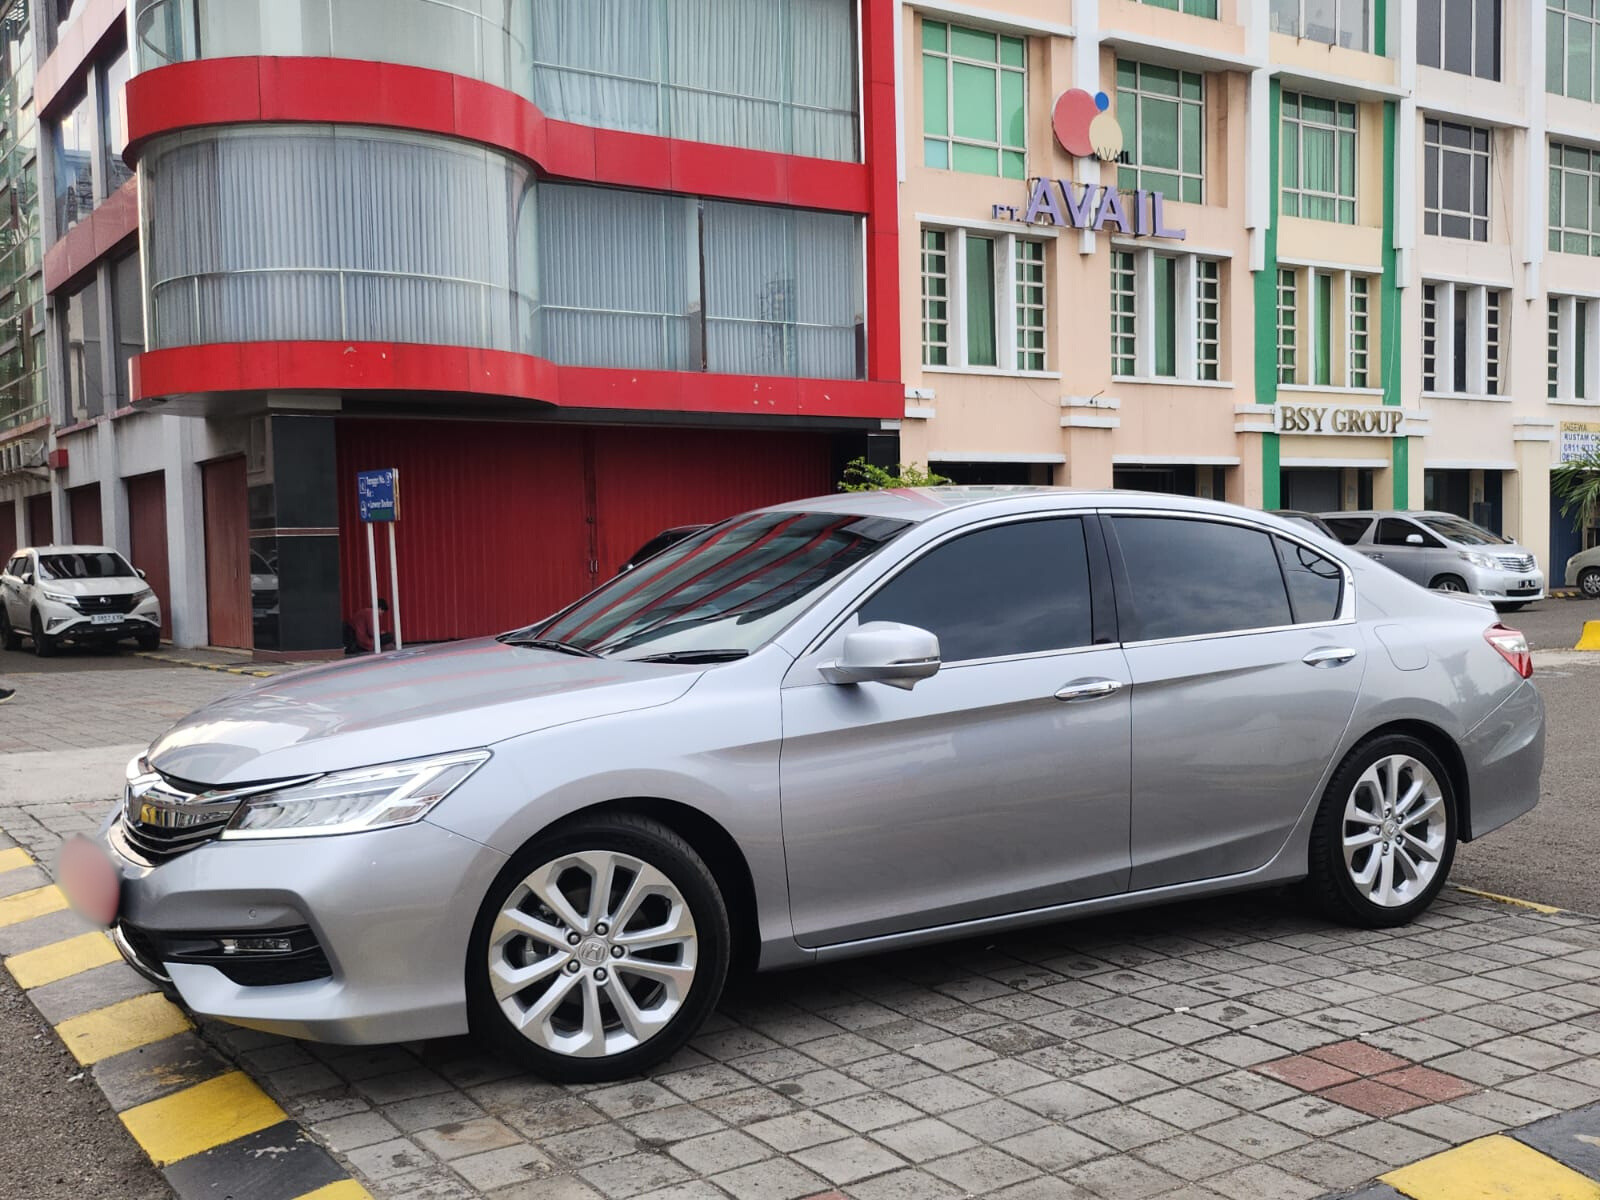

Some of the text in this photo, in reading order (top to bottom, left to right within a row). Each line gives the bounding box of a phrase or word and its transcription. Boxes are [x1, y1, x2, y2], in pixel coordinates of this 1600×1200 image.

[1095, 146, 1133, 165] AVAIL
[1025, 176, 1186, 240] AVAIL
[1280, 406, 1403, 433] BSY GROUP
[1564, 433, 1589, 441] RUSTAM
